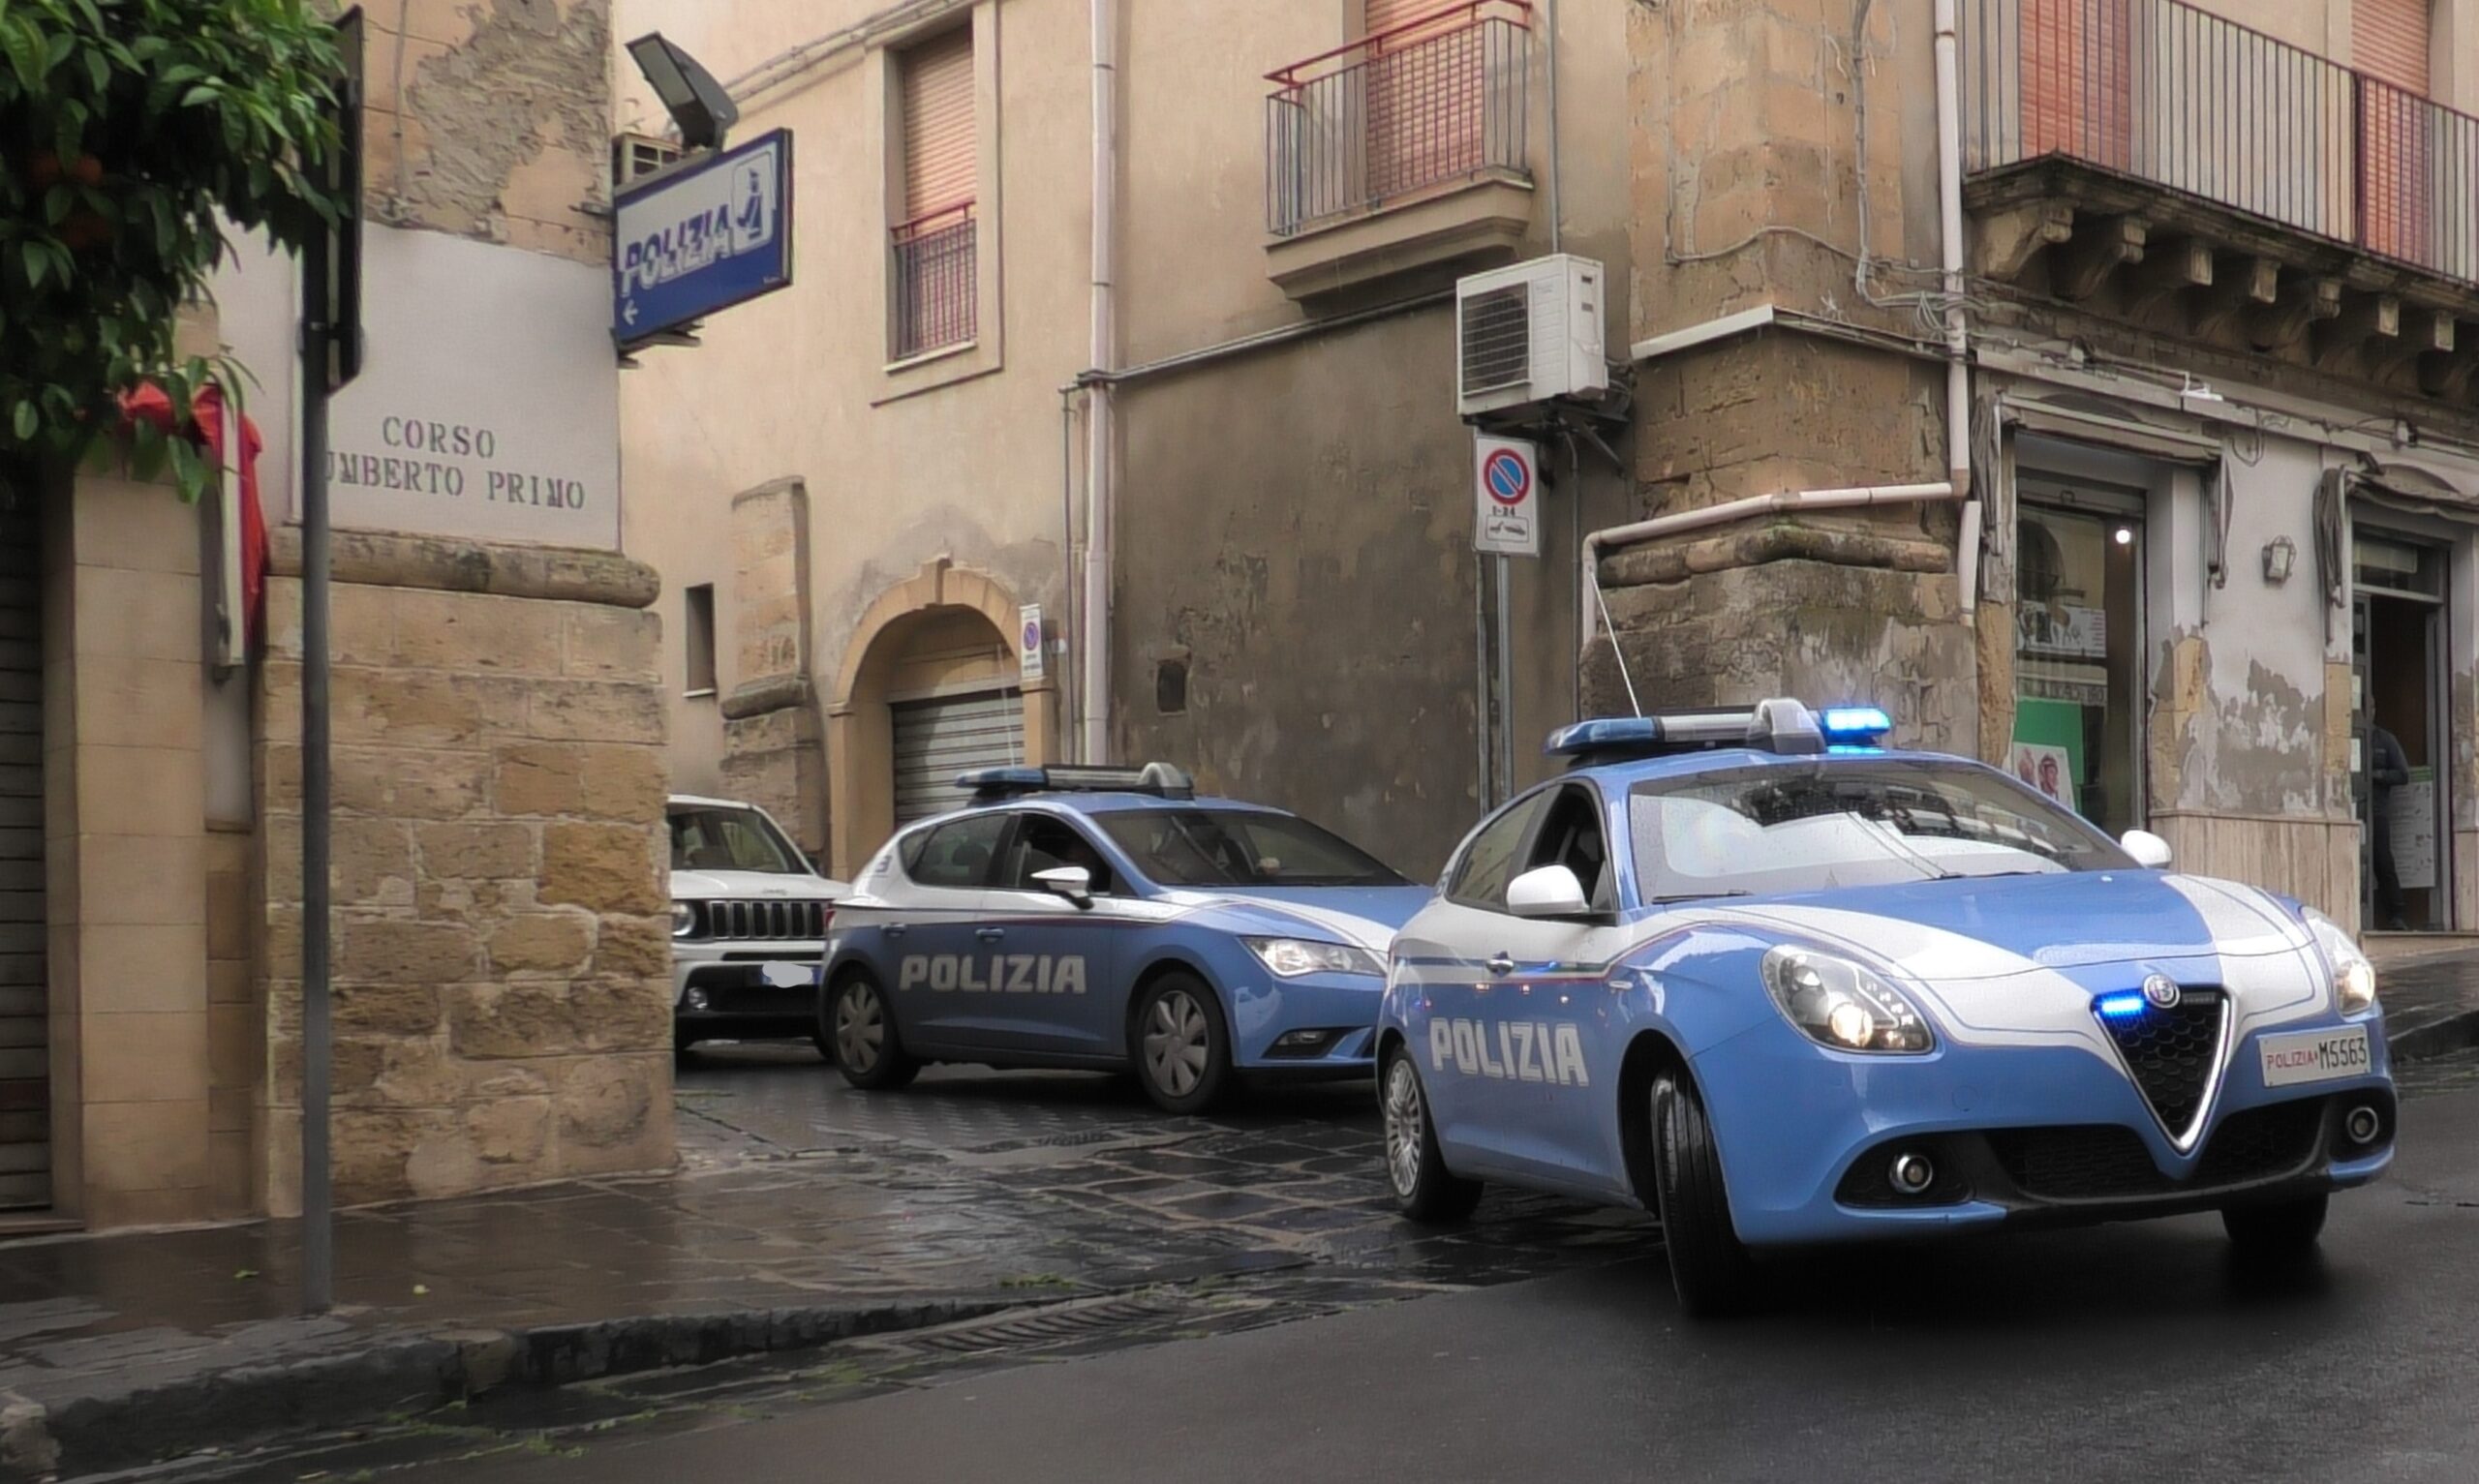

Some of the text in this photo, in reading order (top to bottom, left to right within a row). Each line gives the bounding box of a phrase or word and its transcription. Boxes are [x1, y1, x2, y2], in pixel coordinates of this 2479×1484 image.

[623, 204, 734, 297] POLIZIA
[383, 416, 495, 459] CORSO
[487, 470, 585, 510] PRIMO
[899, 954, 1086, 994] POLIZIA
[1430, 1017, 1589, 1086] POLIZIA
[2266, 1037, 2367, 1070] POLIZIA M5563
